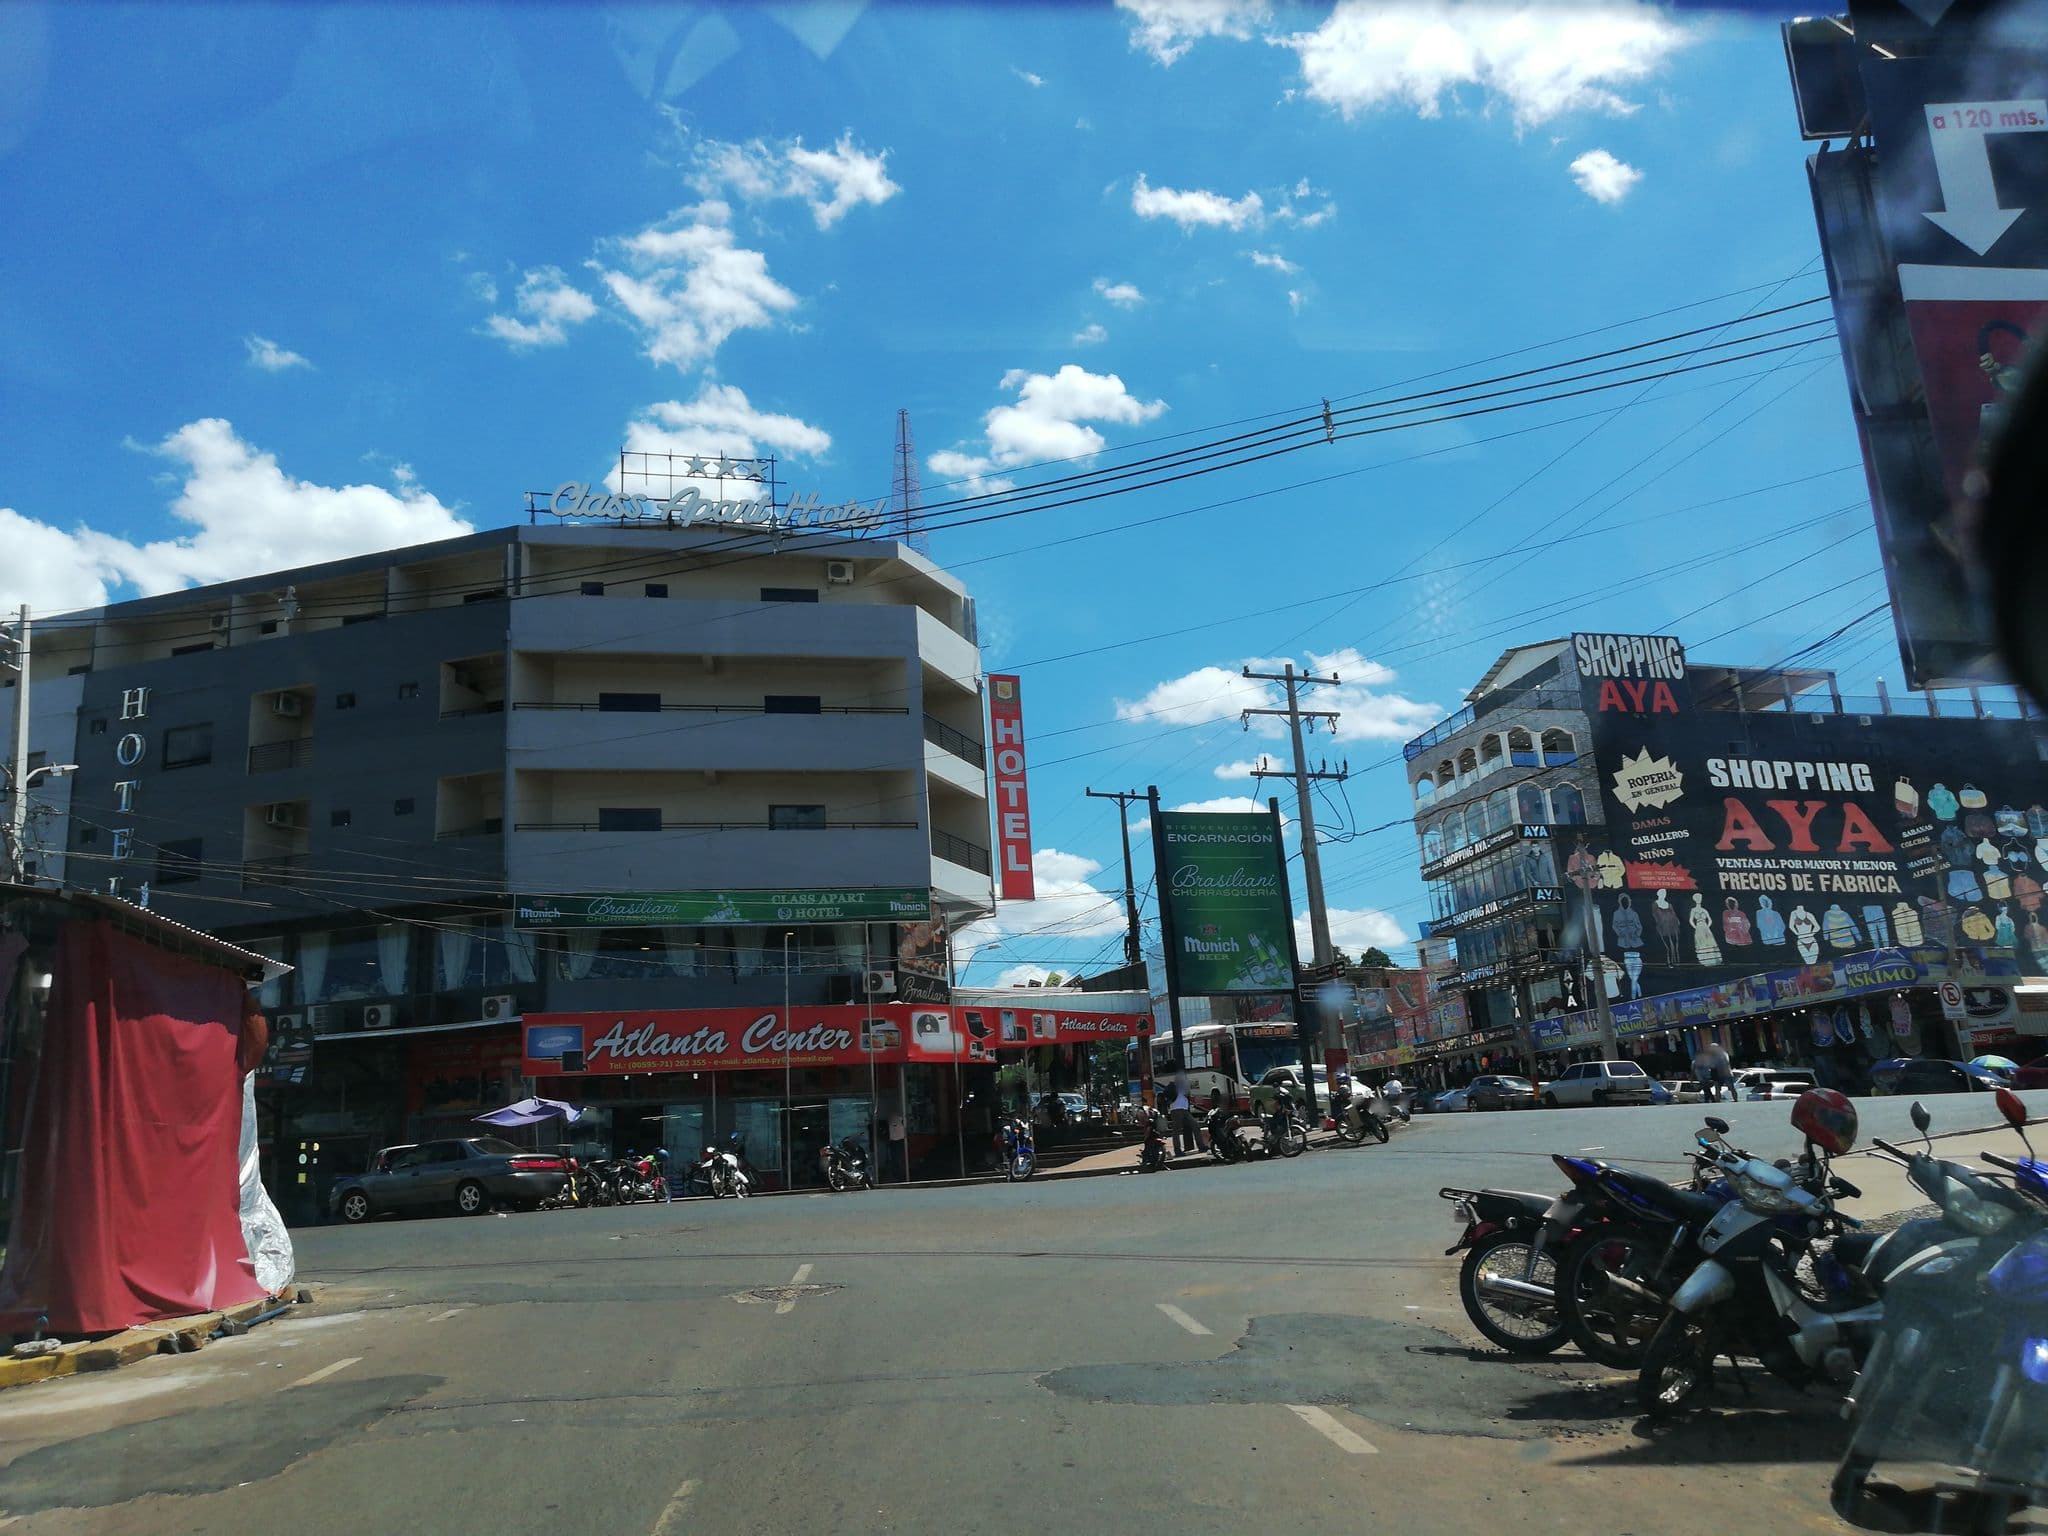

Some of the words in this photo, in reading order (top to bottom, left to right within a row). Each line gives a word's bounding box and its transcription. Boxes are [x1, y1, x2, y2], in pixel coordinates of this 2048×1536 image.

[1933, 115, 1946, 130] a
[1952, 109, 1993, 129] 120
[1999, 109, 2045, 127] mts.
[549, 480, 651, 520] Class
[656, 485, 773, 528] Apart
[778, 489, 890, 531] Hotel
[1575, 633, 1685, 680] SHOPPING
[1599, 679, 1680, 714] AYA
[1627, 768, 1677, 791] ROPERIA
[1706, 758, 1875, 792] SHOPPING
[995, 718, 1030, 872] HOTEL
[1632, 789, 1643, 799] EN
[1646, 782, 1681, 797] GENERAL
[1523, 825, 1549, 837] AYA
[1632, 816, 1672, 831] DAMAS
[1714, 796, 1897, 853] AYA
[1167, 831, 1273, 843] ENCARNACIÓN
[1630, 829, 1691, 847] CABALLEROS
[1442, 846, 1474, 868] SHOPPING
[1474, 839, 1488, 855] AYA
[1638, 847, 1675, 861] NIÑOS
[1906, 853, 1943, 869] MANTELS
[1715, 857, 1763, 869] VENTAS
[1763, 858, 1780, 869] AL
[1780, 859, 1804, 870] POR
[1804, 859, 1842, 870] MAYOR
[1841, 860, 1852, 870] Y
[1852, 860, 1898, 871] MENOR
[1171, 864, 1278, 888] Brasiliani
[1718, 871, 1788, 891] PRECIOS
[1791, 872, 1814, 891] DE
[1818, 873, 1902, 894] FABRICA
[587, 895, 680, 915] Brasiliani
[771, 894, 820, 905] CLASS
[820, 892, 866, 904] APART
[890, 899, 927, 912] Munich
[520, 906, 561, 918] Munich
[795, 907, 844, 918] HOTEL
[1451, 905, 1485, 926] SHOPPING
[1484, 900, 1499, 916] AYA
[1183, 936, 1240, 953] Munich
[1461, 963, 1495, 983] SHOPPING
[1845, 961, 1870, 974] Casa
[1846, 966, 1917, 989] ASKIMO
[1562, 969, 1579, 1007] AYA
[1059, 1016, 1096, 1031] Atlanta
[1099, 1017, 1129, 1032] Center
[1617, 1020, 1649, 1034] ASKIMO
[587, 1020, 730, 1061] Atlanta
[740, 1013, 854, 1054] Center
[675, 1059, 690, 1067] 202
